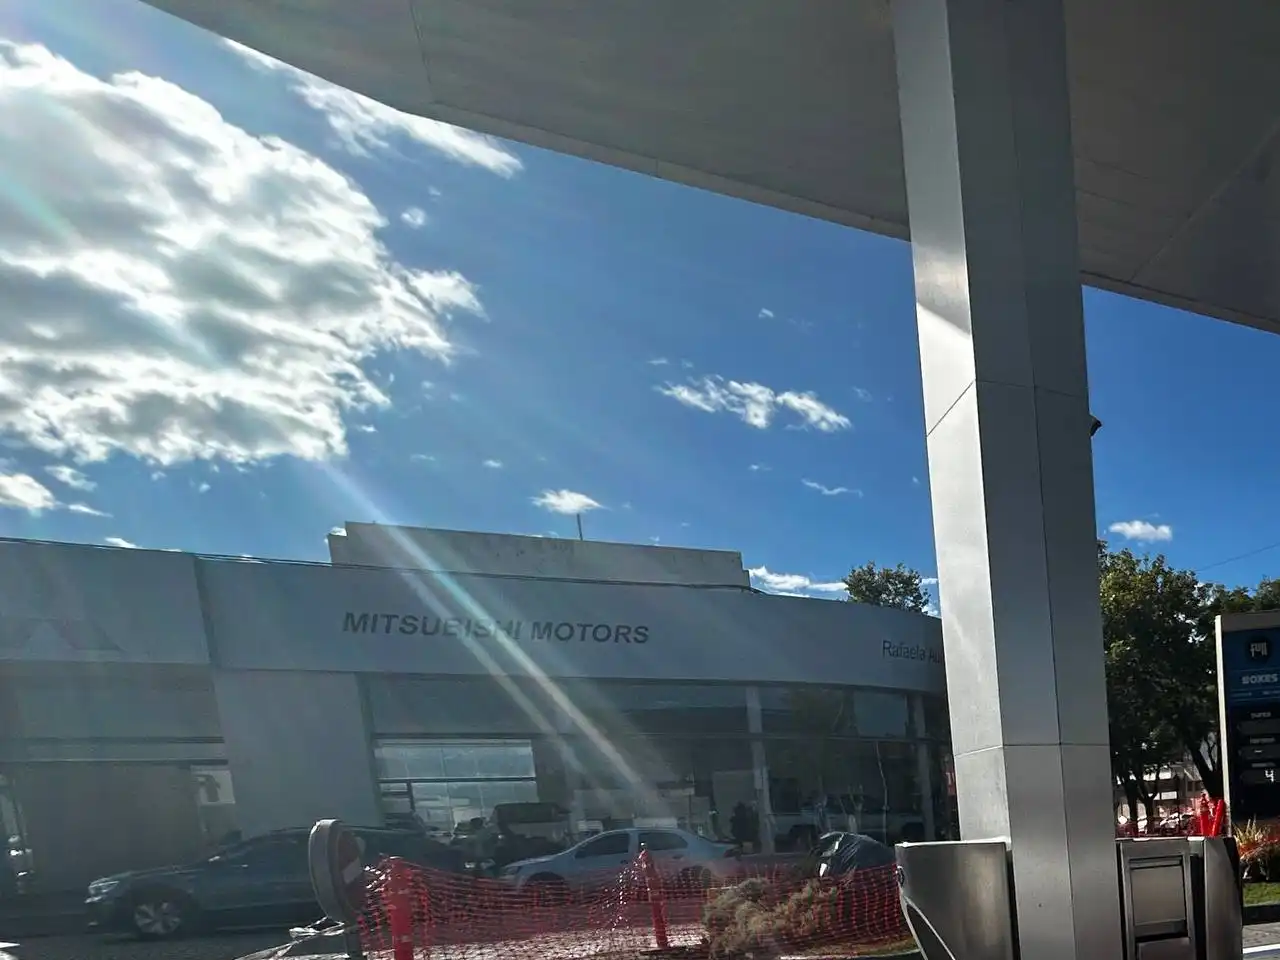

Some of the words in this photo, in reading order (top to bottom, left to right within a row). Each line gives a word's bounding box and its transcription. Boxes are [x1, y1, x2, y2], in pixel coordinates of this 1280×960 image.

[343, 612, 521, 641] MITSUBISHI
[531, 621, 649, 644] MOTORS
[882, 639, 926, 661] Rafaela
